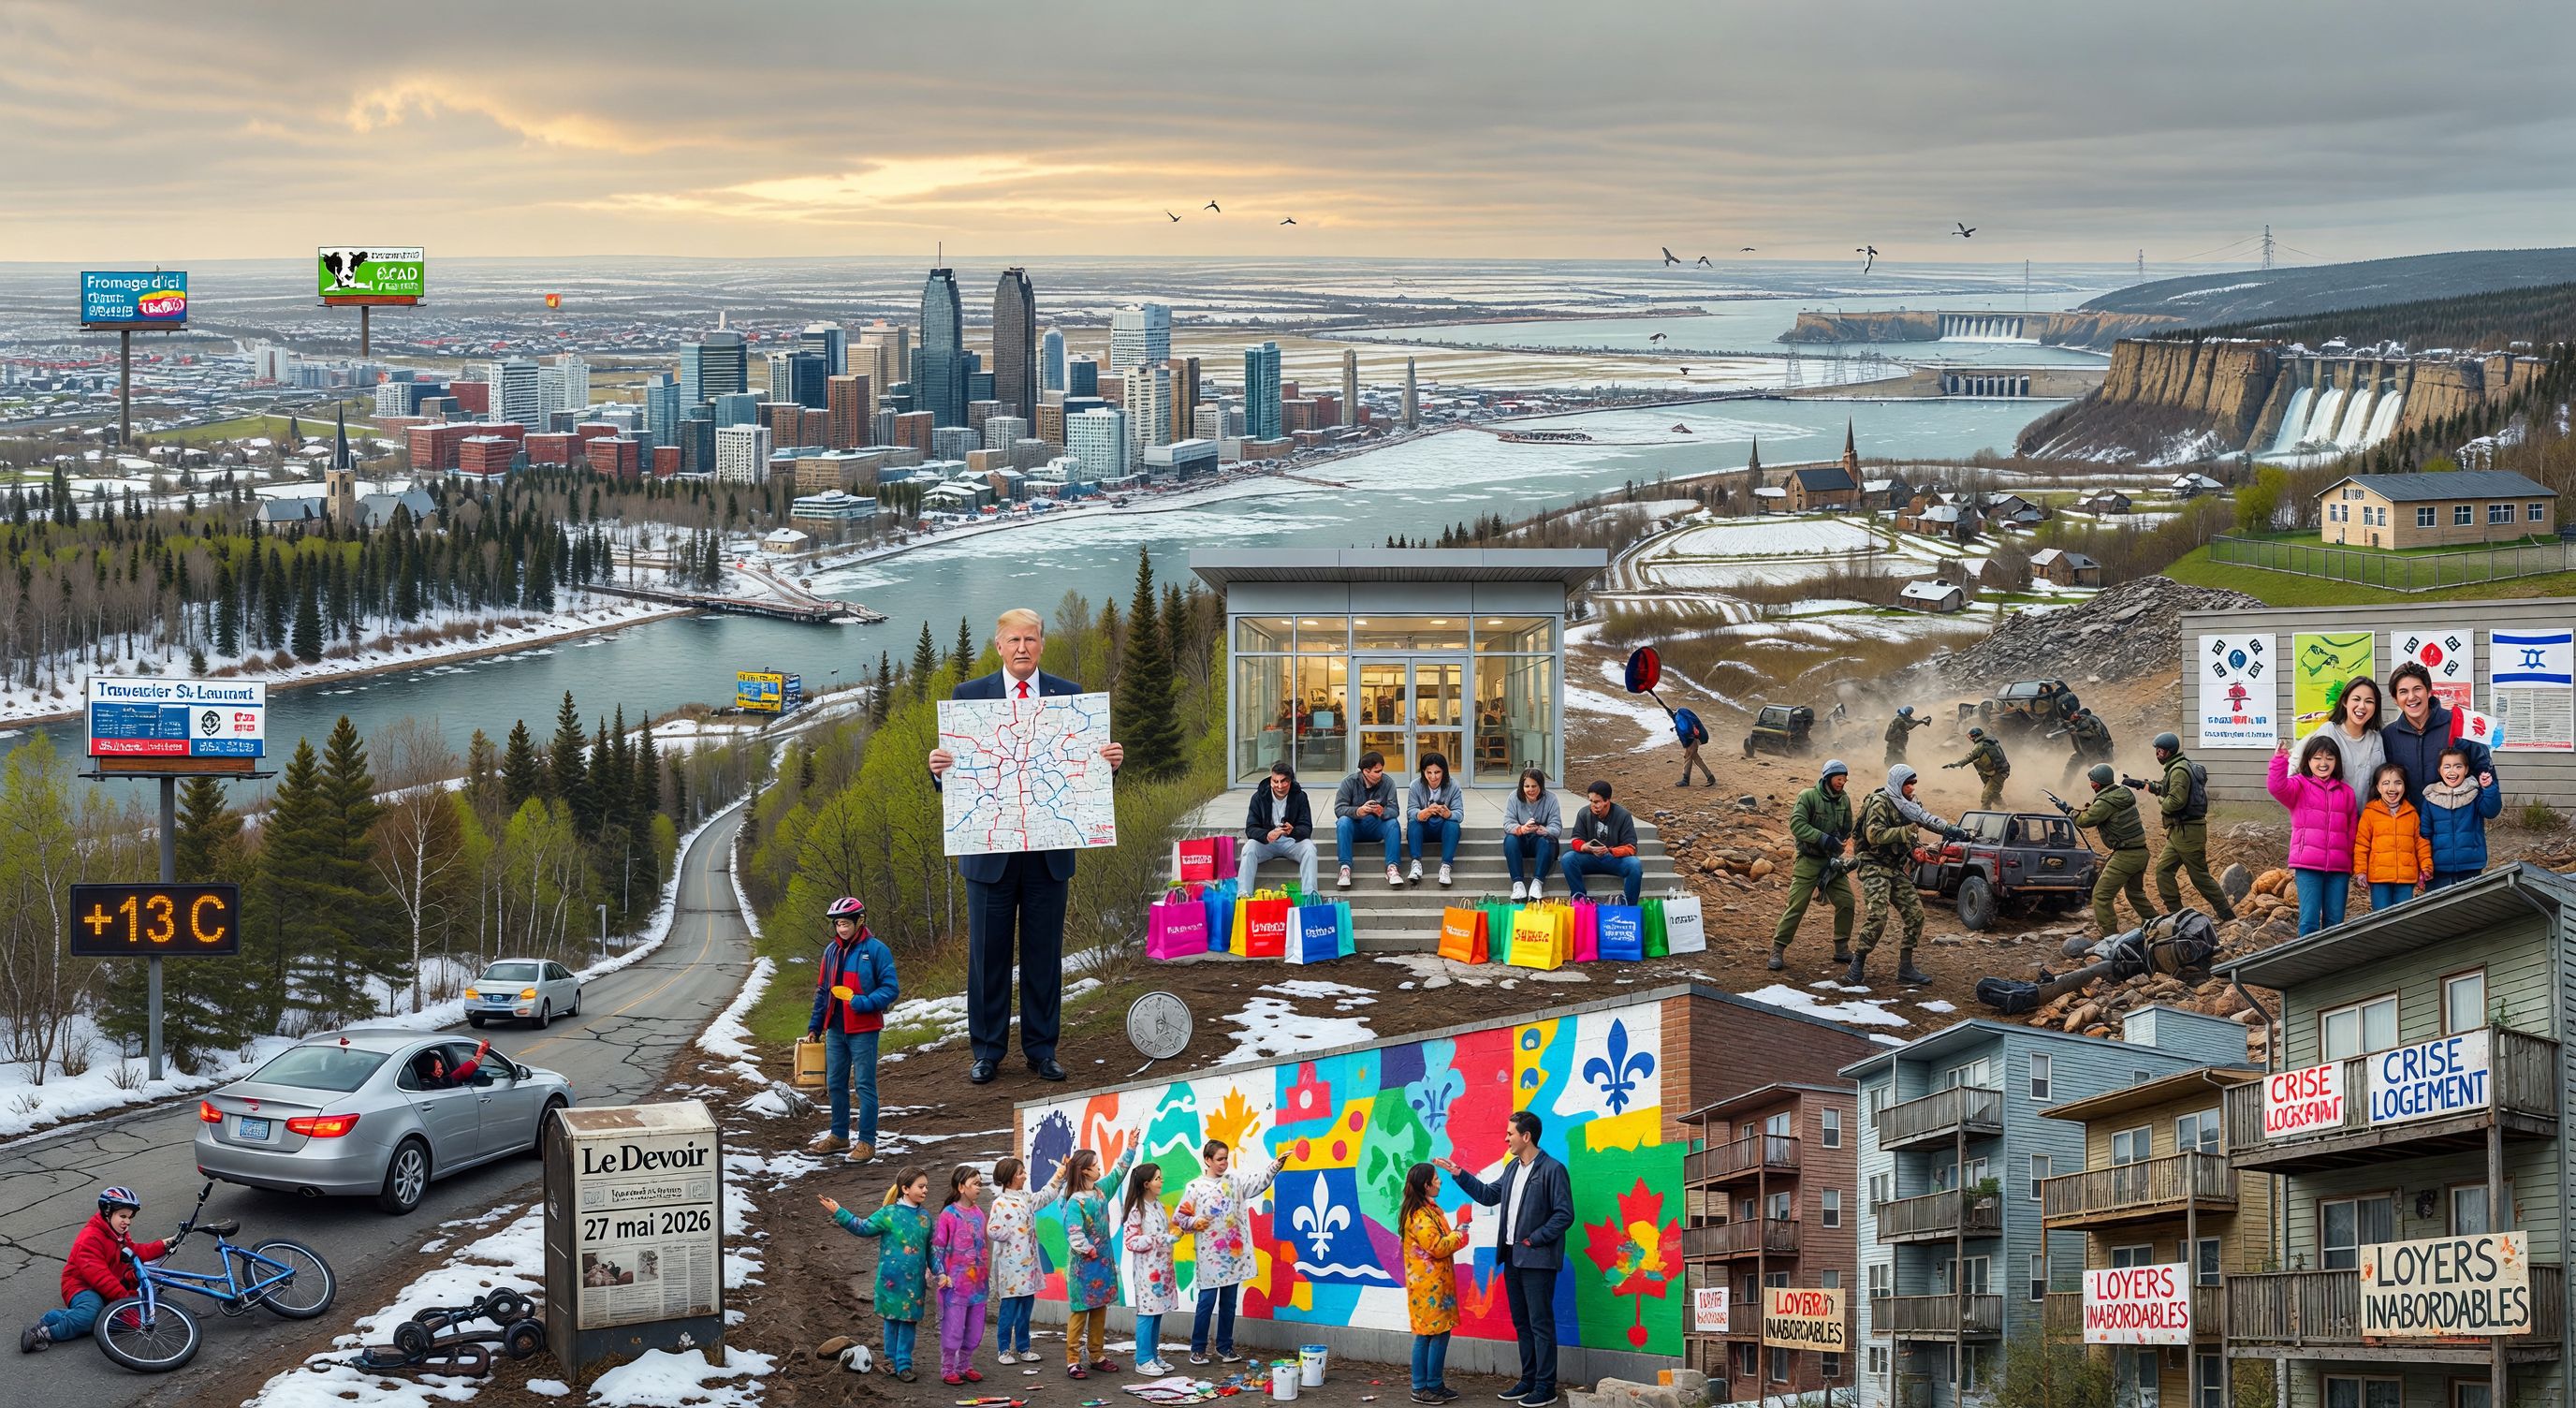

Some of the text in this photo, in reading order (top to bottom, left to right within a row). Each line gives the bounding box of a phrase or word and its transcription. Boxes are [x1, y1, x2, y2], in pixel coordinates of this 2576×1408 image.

[88, 274, 180, 291] Fromage d'ici
[83, 894, 226, 943] +13 C
[2382, 1036, 2465, 1085] CRISE
[2271, 1064, 2333, 1105] CRISE
[2372, 1068, 2488, 1122] LOGEMENT
[581, 1140, 710, 1175] Le Devoir
[584, 1210, 711, 1241] 27 mai 2026
[2377, 1238, 2497, 1287] LOYERS
[2097, 1267, 2175, 1300] LOYERS
[2086, 1300, 2188, 1330] INABORDABLES
[2365, 1285, 2529, 1329] INABORDABLES
